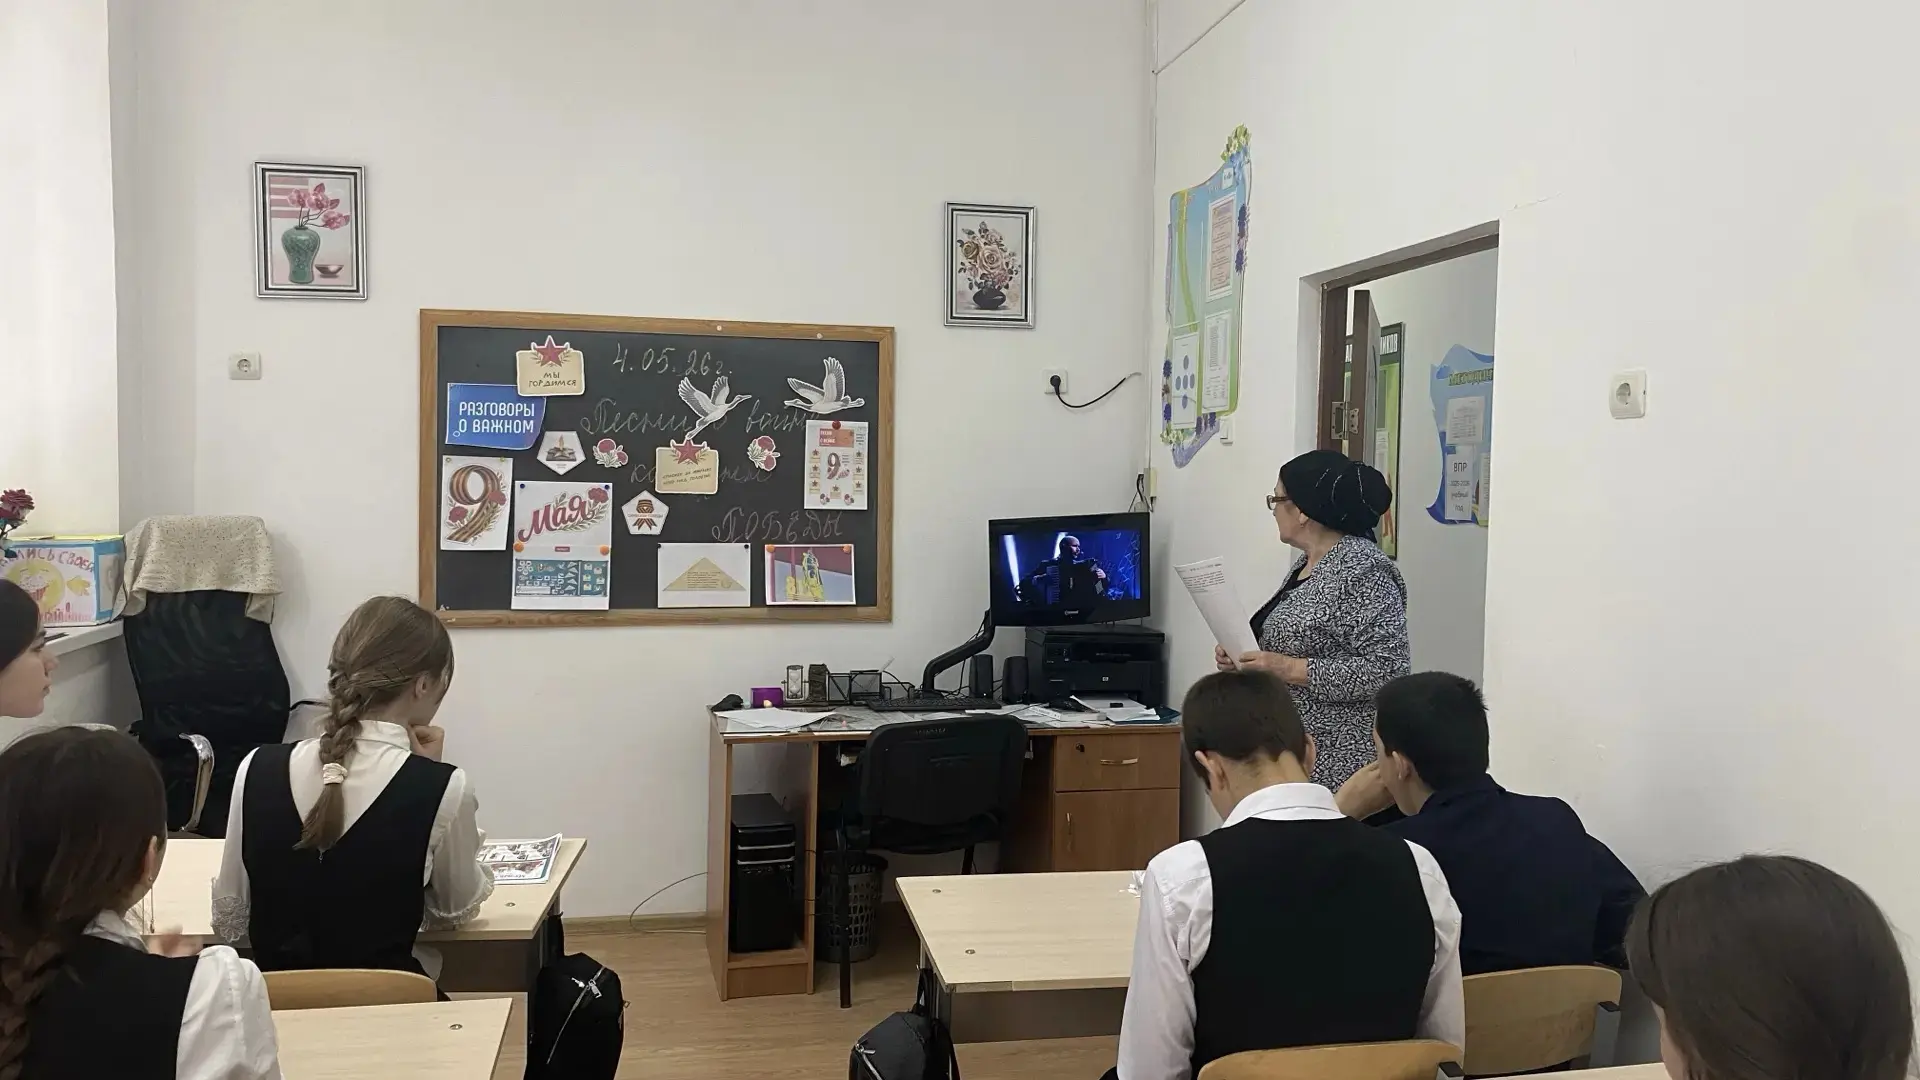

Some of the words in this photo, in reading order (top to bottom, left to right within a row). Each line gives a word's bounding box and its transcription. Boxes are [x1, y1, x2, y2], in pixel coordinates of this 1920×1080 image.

[543, 371, 560, 379] МЫ
[528, 379, 577, 388] ГОРДИМСЯ
[459, 401, 535, 417] РАЗГОВОРЫ
[458, 418, 468, 433] О
[472, 419, 534, 434] ВАЖНОМ
[1453, 462, 1468, 473] ВПР
[517, 495, 595, 543] Мая
